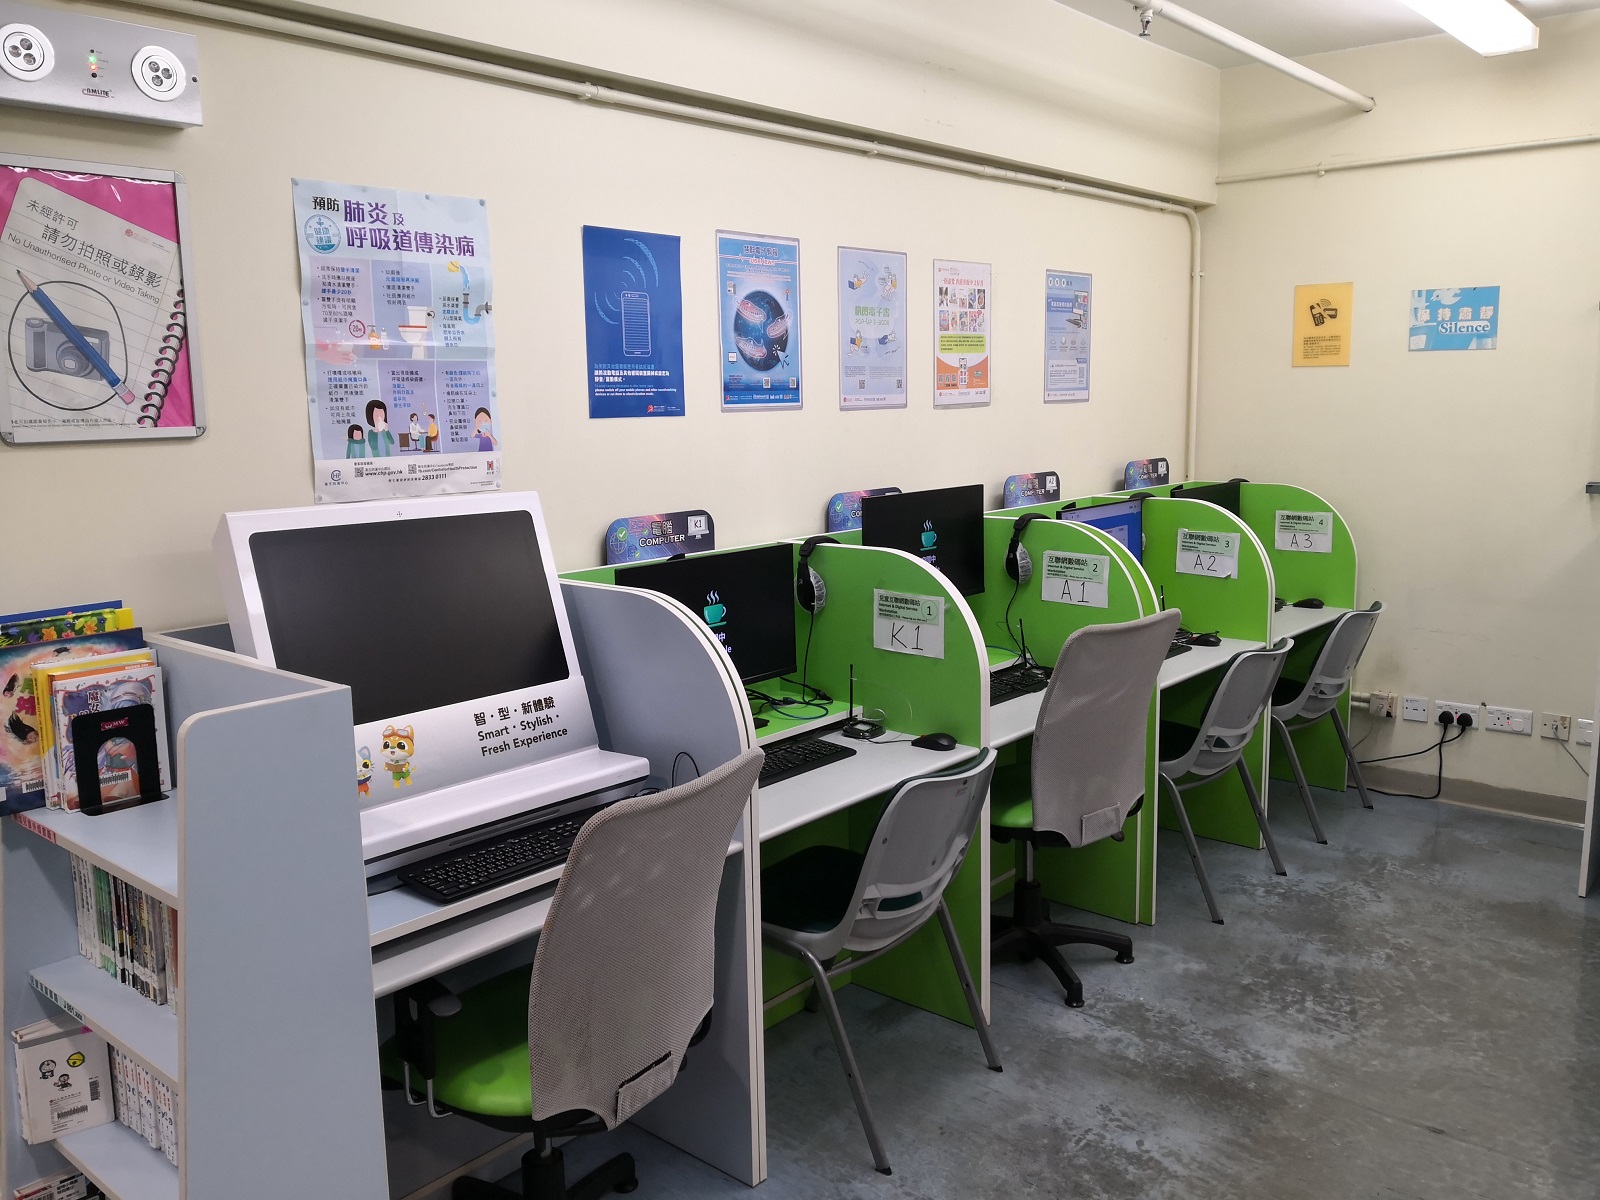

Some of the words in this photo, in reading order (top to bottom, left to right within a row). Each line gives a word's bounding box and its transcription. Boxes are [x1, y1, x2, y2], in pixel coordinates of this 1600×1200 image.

[312, 196, 340, 212] 預防
[27, 199, 79, 230] 未經許可
[345, 226, 475, 257] 呼吸道傳染病
[41, 224, 163, 288] 請勿拍照或錄影
[8, 232, 21, 245] No
[22, 239, 77, 268] Unauthorised
[79, 262, 102, 279] Photo
[113, 277, 136, 293] Video
[137, 287, 160, 304] Taking
[1417, 306, 1494, 323] 保持肅靜
[1439, 321, 1491, 334] Silence
[651, 521, 673, 536] 電腦
[639, 534, 685, 547] COMPUTER
[1224, 540, 1230, 549] 3
[1290, 533, 1313, 549] A3
[1092, 563, 1098, 573] 2
[1193, 553, 1218, 572] A2
[1061, 579, 1090, 603] A1
[926, 605, 932, 616] 1
[890, 622, 924, 651] K1
[477, 726, 510, 741] Smart
[520, 714, 553, 731] Stylish
[481, 741, 511, 757] Fresh
[512, 728, 568, 748] Experience
